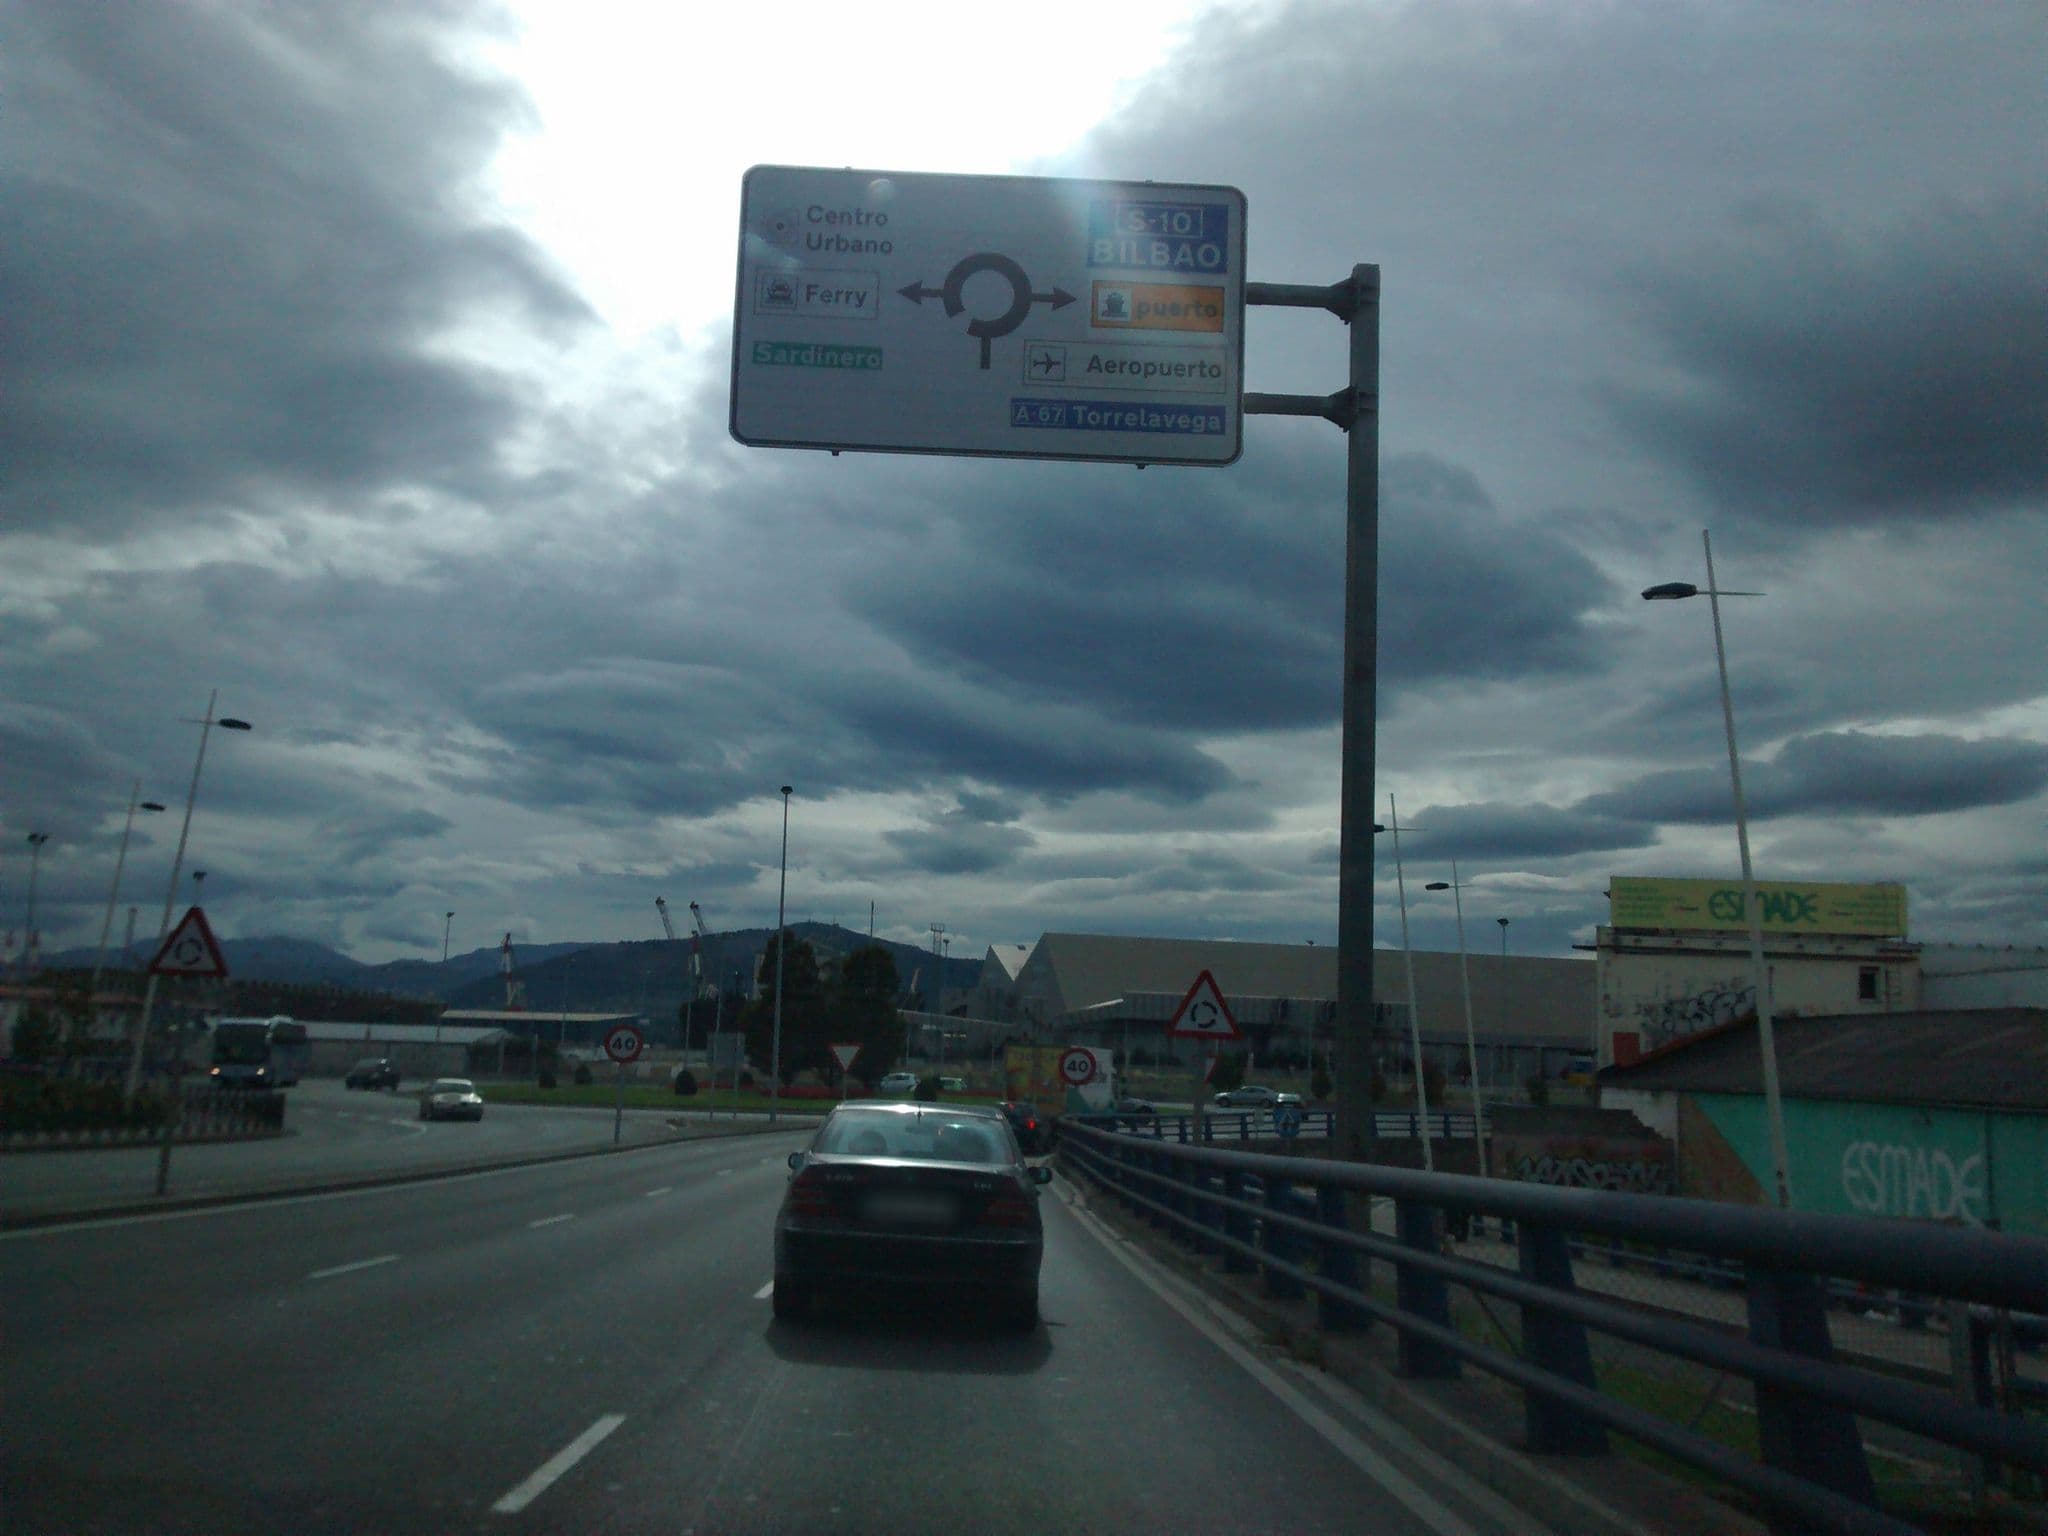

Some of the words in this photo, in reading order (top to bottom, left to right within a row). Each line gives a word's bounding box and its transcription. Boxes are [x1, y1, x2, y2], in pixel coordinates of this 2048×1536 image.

[806, 205, 888, 226] Centro
[1128, 207, 1193, 234] S-10
[806, 232, 892, 255] Urbano
[1094, 238, 1221, 268] BILBAO
[806, 284, 868, 308] Ferry
[1136, 300, 1218, 321] puerto
[755, 343, 881, 368] Sardinero
[1086, 355, 1222, 379] Aeropuerto
[1015, 403, 1064, 423] A-67
[1073, 404, 1222, 433] Torrelavega
[611, 1036, 636, 1050] 40
[1067, 1060, 1089, 1073] 40
[1842, 1140, 1986, 1229] ESMADE
